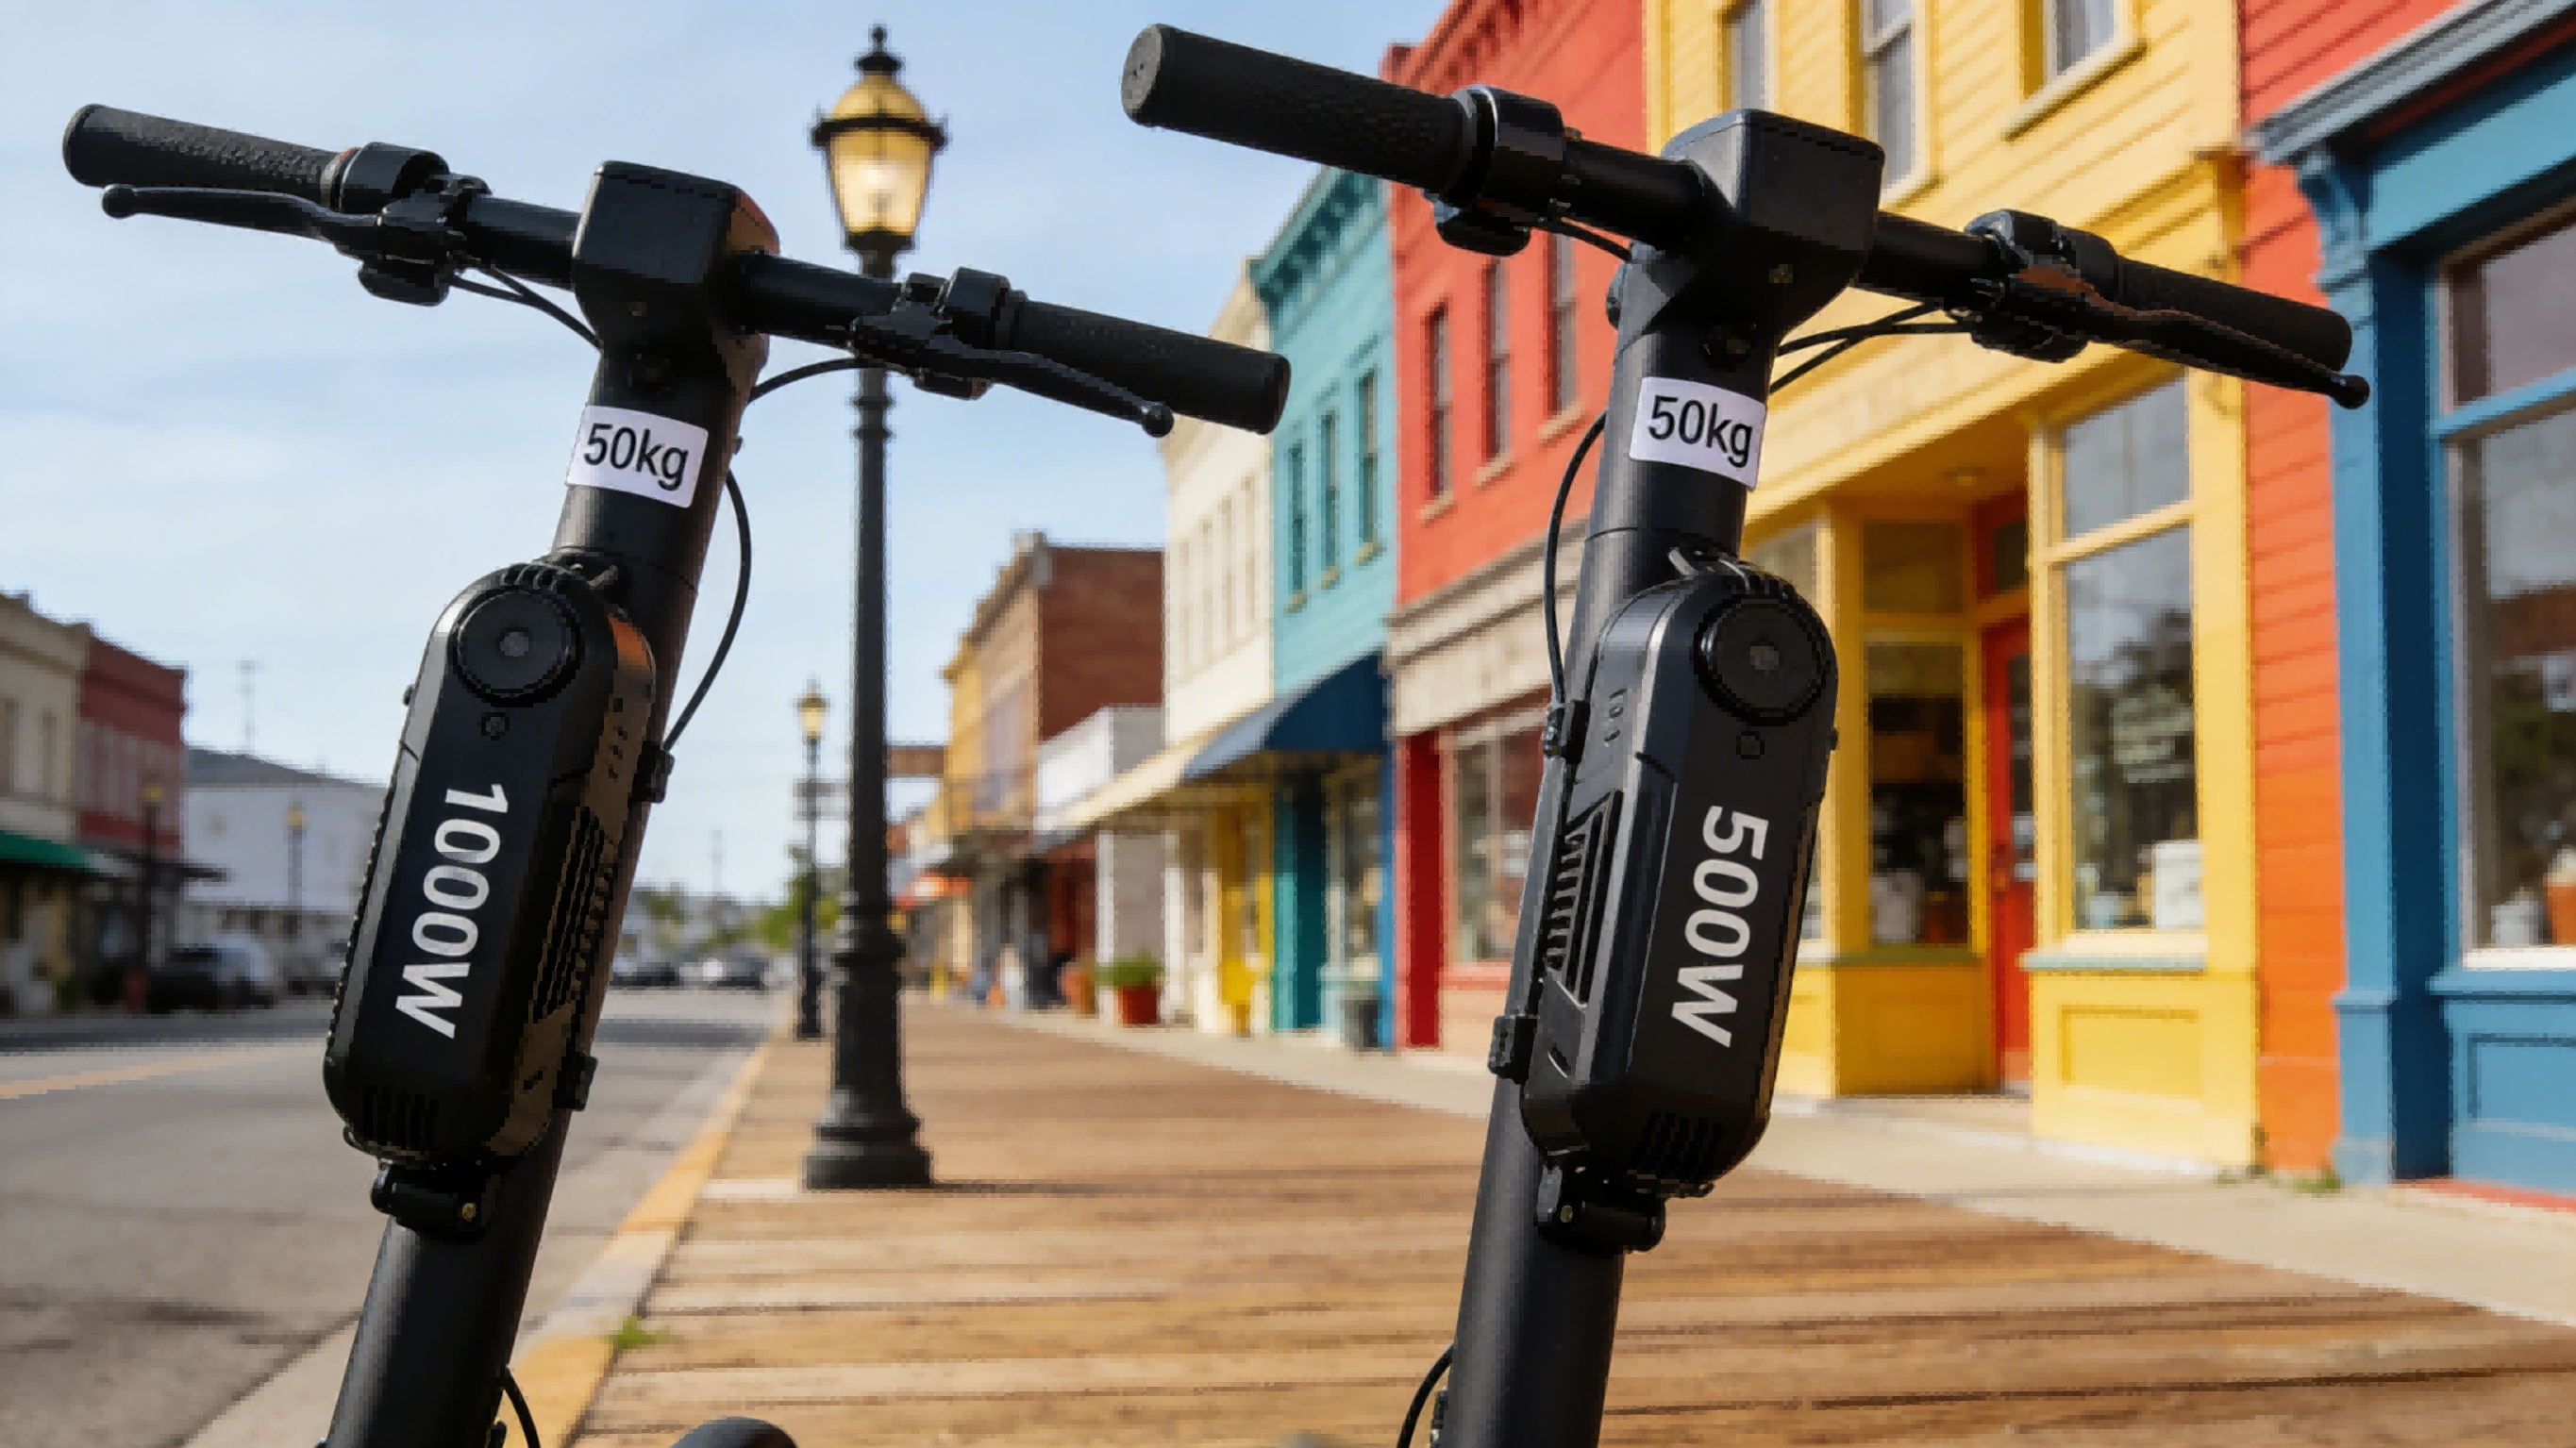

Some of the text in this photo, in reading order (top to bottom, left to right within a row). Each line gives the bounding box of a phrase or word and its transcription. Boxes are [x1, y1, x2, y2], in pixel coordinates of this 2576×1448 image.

[583, 423, 690, 491] 50kg
[1648, 394, 1754, 469] 50kg
[395, 784, 509, 1039] 1000W
[1671, 805, 1769, 1048] 500W
